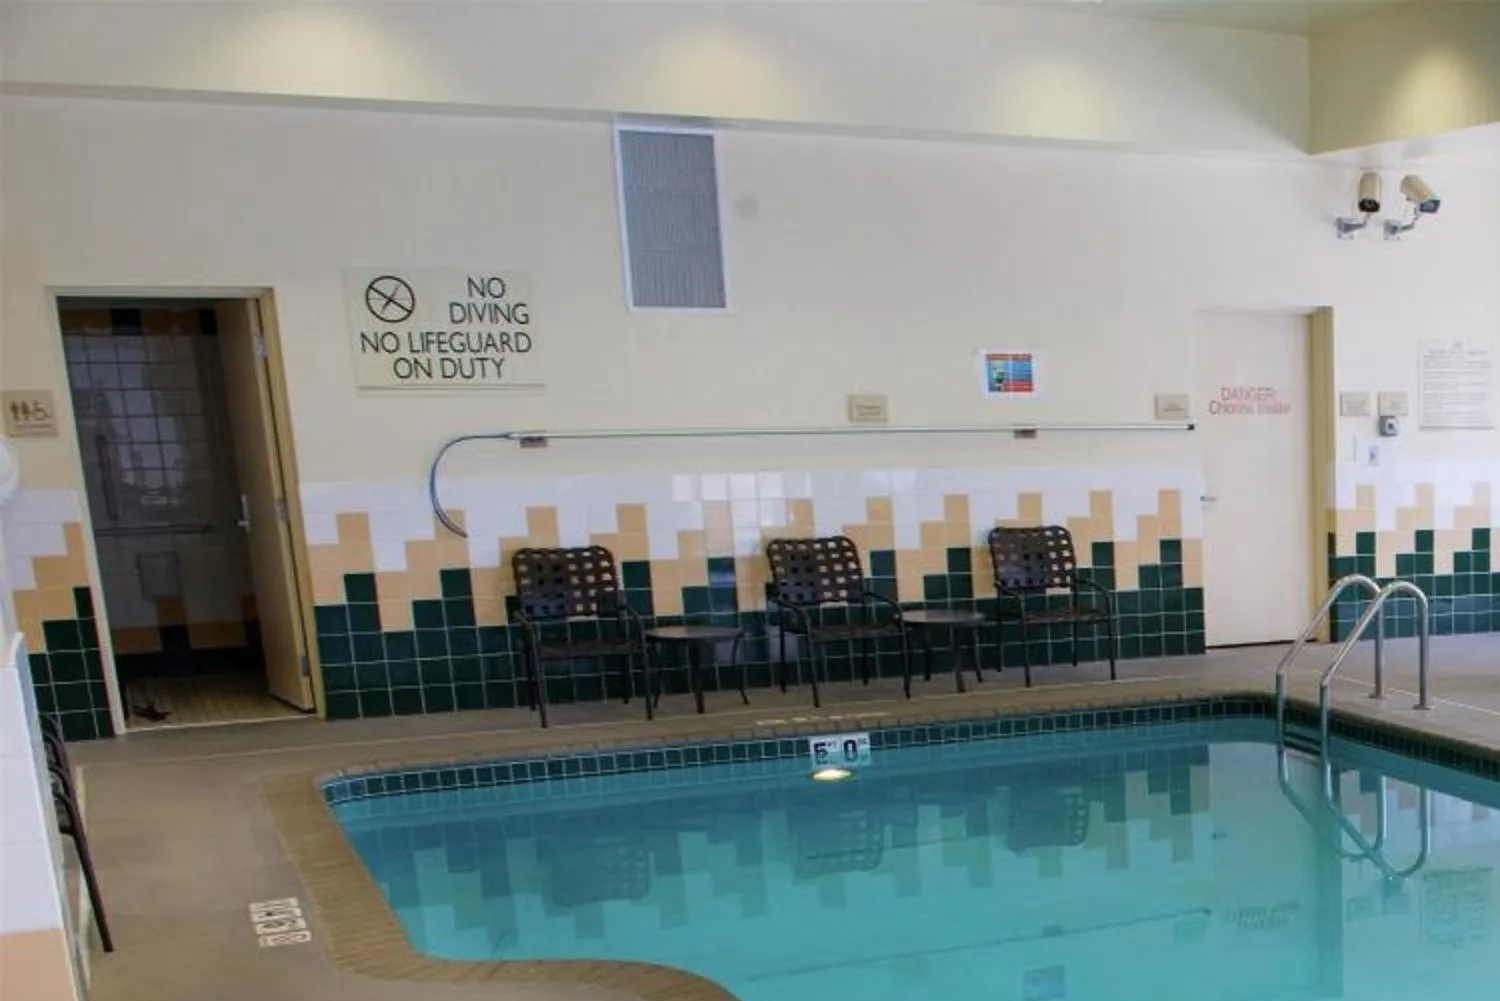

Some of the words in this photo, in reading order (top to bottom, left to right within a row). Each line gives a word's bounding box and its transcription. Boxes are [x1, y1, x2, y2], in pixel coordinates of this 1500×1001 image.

[467, 276, 506, 299] NO
[449, 302, 530, 325] DIVING
[360, 331, 400, 354] NO
[408, 331, 532, 354] LIFEGUARD
[393, 357, 433, 380] ON
[440, 357, 506, 380] DUTY
